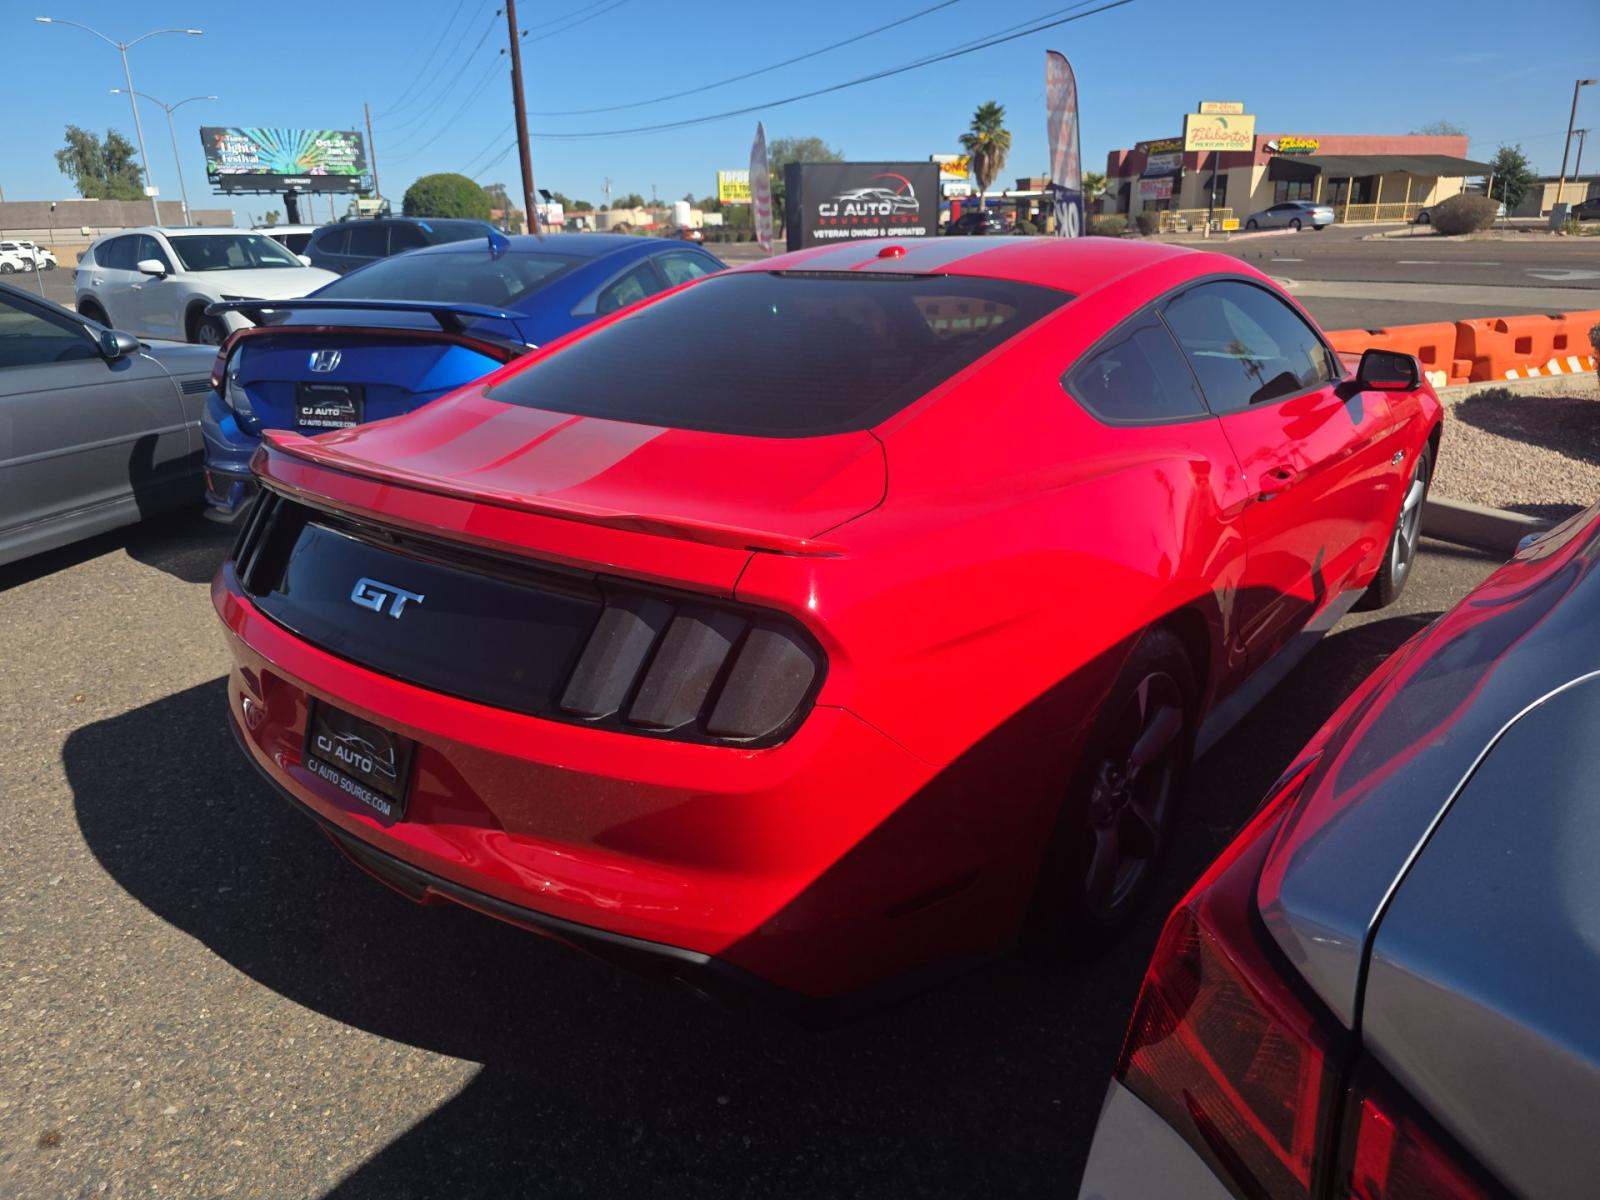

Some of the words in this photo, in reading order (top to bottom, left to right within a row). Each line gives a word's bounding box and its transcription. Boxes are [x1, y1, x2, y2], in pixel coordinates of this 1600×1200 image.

[818, 203, 839, 216] CJ
[844, 202, 892, 216] AUTO
[813, 229, 850, 238] VETERAN
[850, 228, 879, 237] OWNED
[880, 228, 887, 237] &
[887, 227, 926, 237] OPERATED
[302, 407, 313, 415] CJ
[315, 408, 340, 416] AUTO
[307, 419, 322, 427] AUTO
[351, 577, 425, 619] GT
[317, 735, 332, 752] CJ
[335, 746, 372, 773] AUTO
[308, 759, 318, 772] CJ
[318, 765, 339, 784] AUTO
[340, 777, 391, 816] SOURCE.COM
